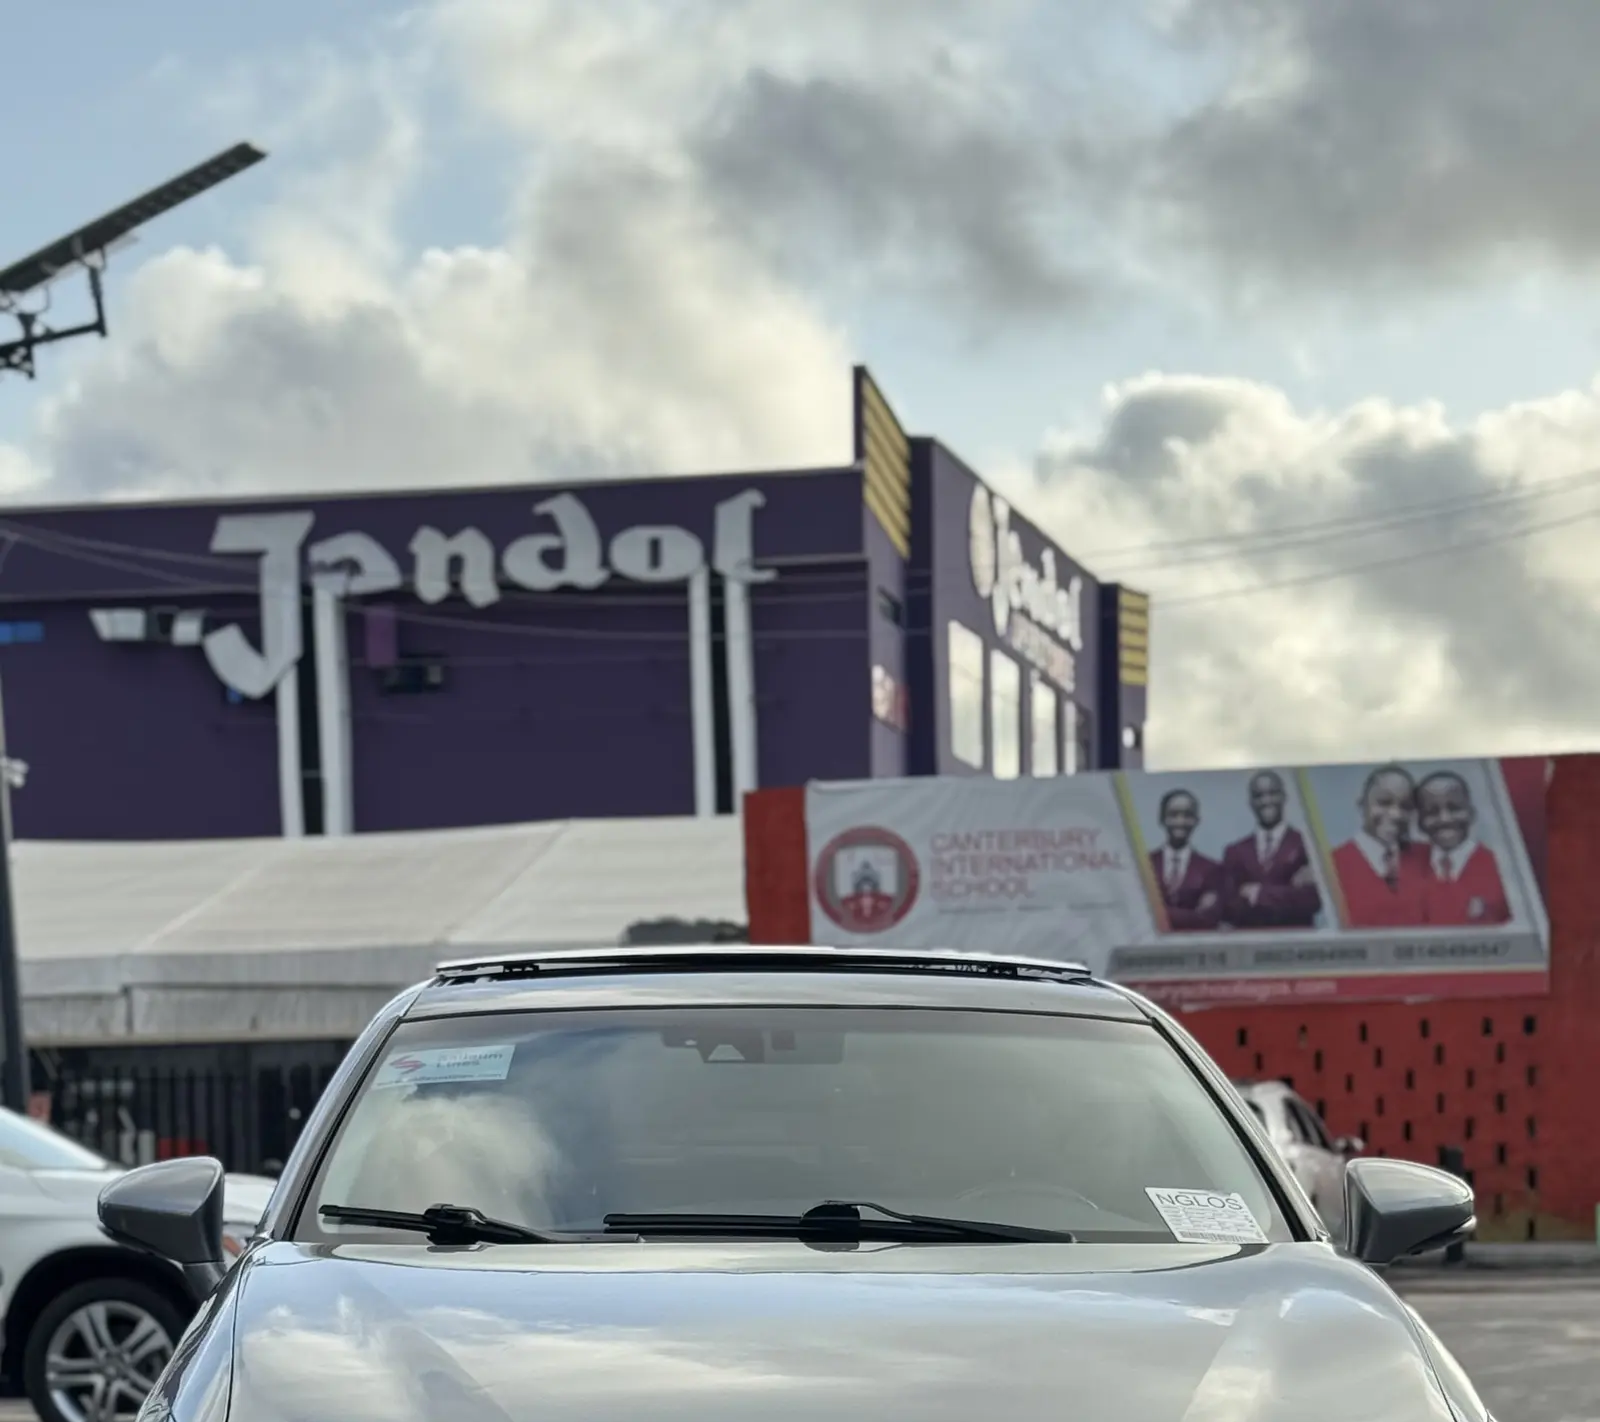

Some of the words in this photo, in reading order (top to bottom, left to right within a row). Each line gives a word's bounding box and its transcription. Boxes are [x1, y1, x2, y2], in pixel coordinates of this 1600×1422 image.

[930, 827, 1101, 855] CANTERBURY
[930, 850, 1126, 879] INTERNATIONAL
[930, 874, 1036, 901] SCHOOL
[1155, 1193, 1243, 1211] NGLOS
